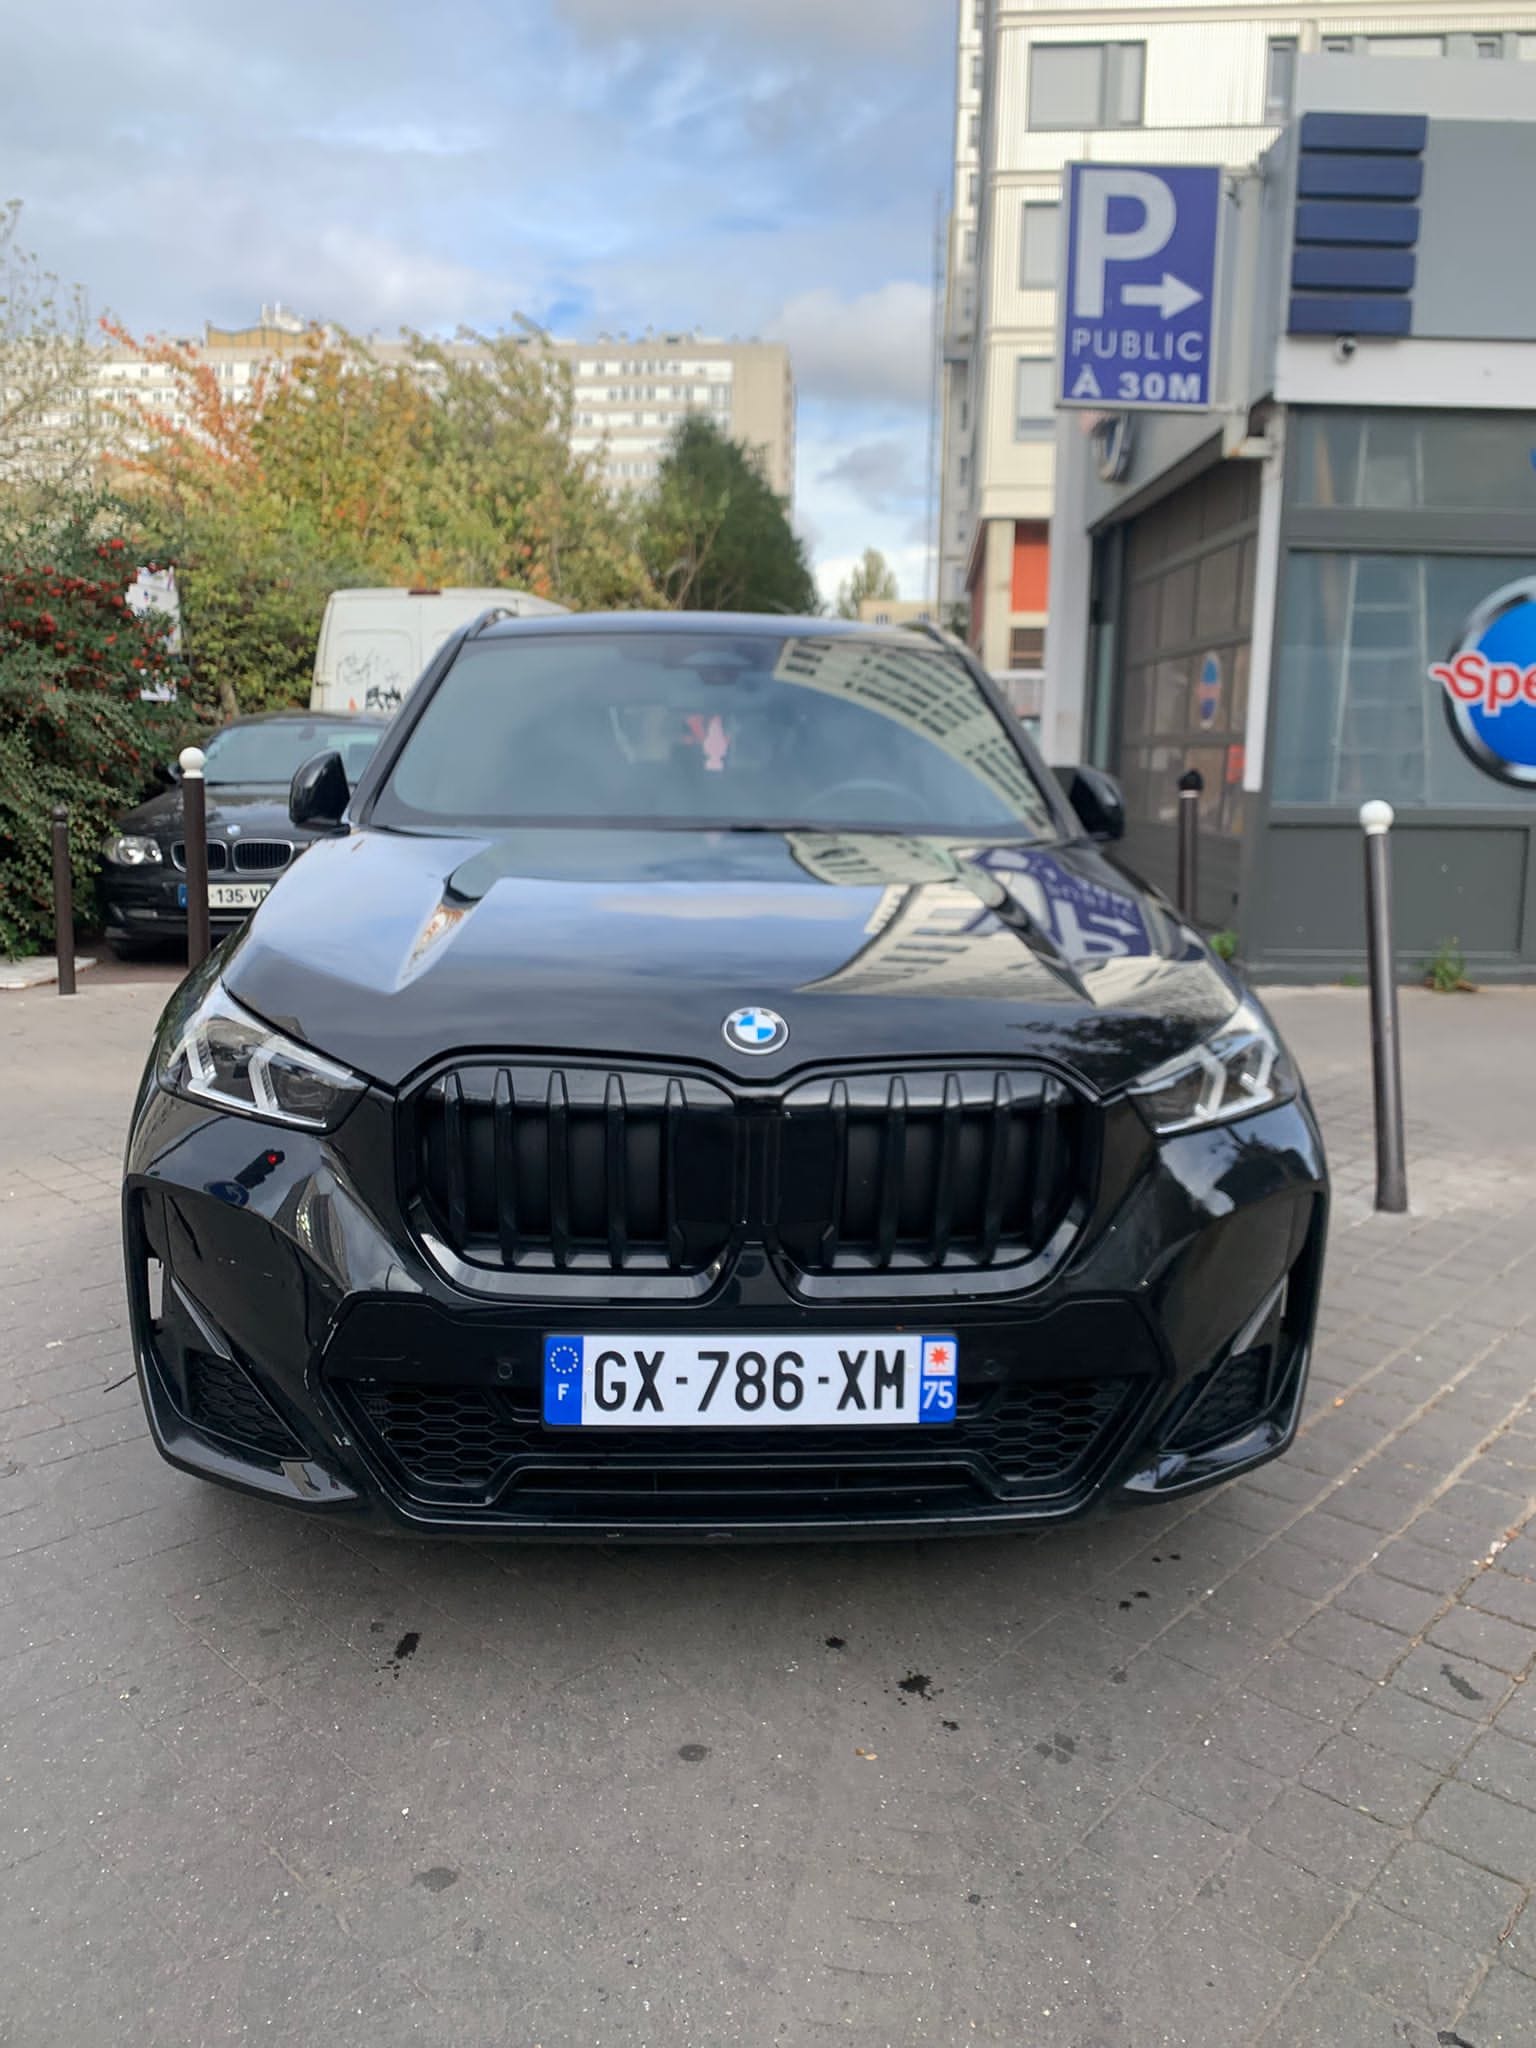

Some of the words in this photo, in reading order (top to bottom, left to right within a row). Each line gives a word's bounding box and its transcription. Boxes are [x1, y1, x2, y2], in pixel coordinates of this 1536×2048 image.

[1074, 169, 1177, 318] P
[1072, 328, 1203, 361] PUBLIC
[1071, 363, 1102, 398] À
[1118, 371, 1200, 402] 30M
[557, 1383, 570, 1401] F
[594, 1349, 906, 1412] GX-786-XM
[922, 1380, 954, 1410] 75
